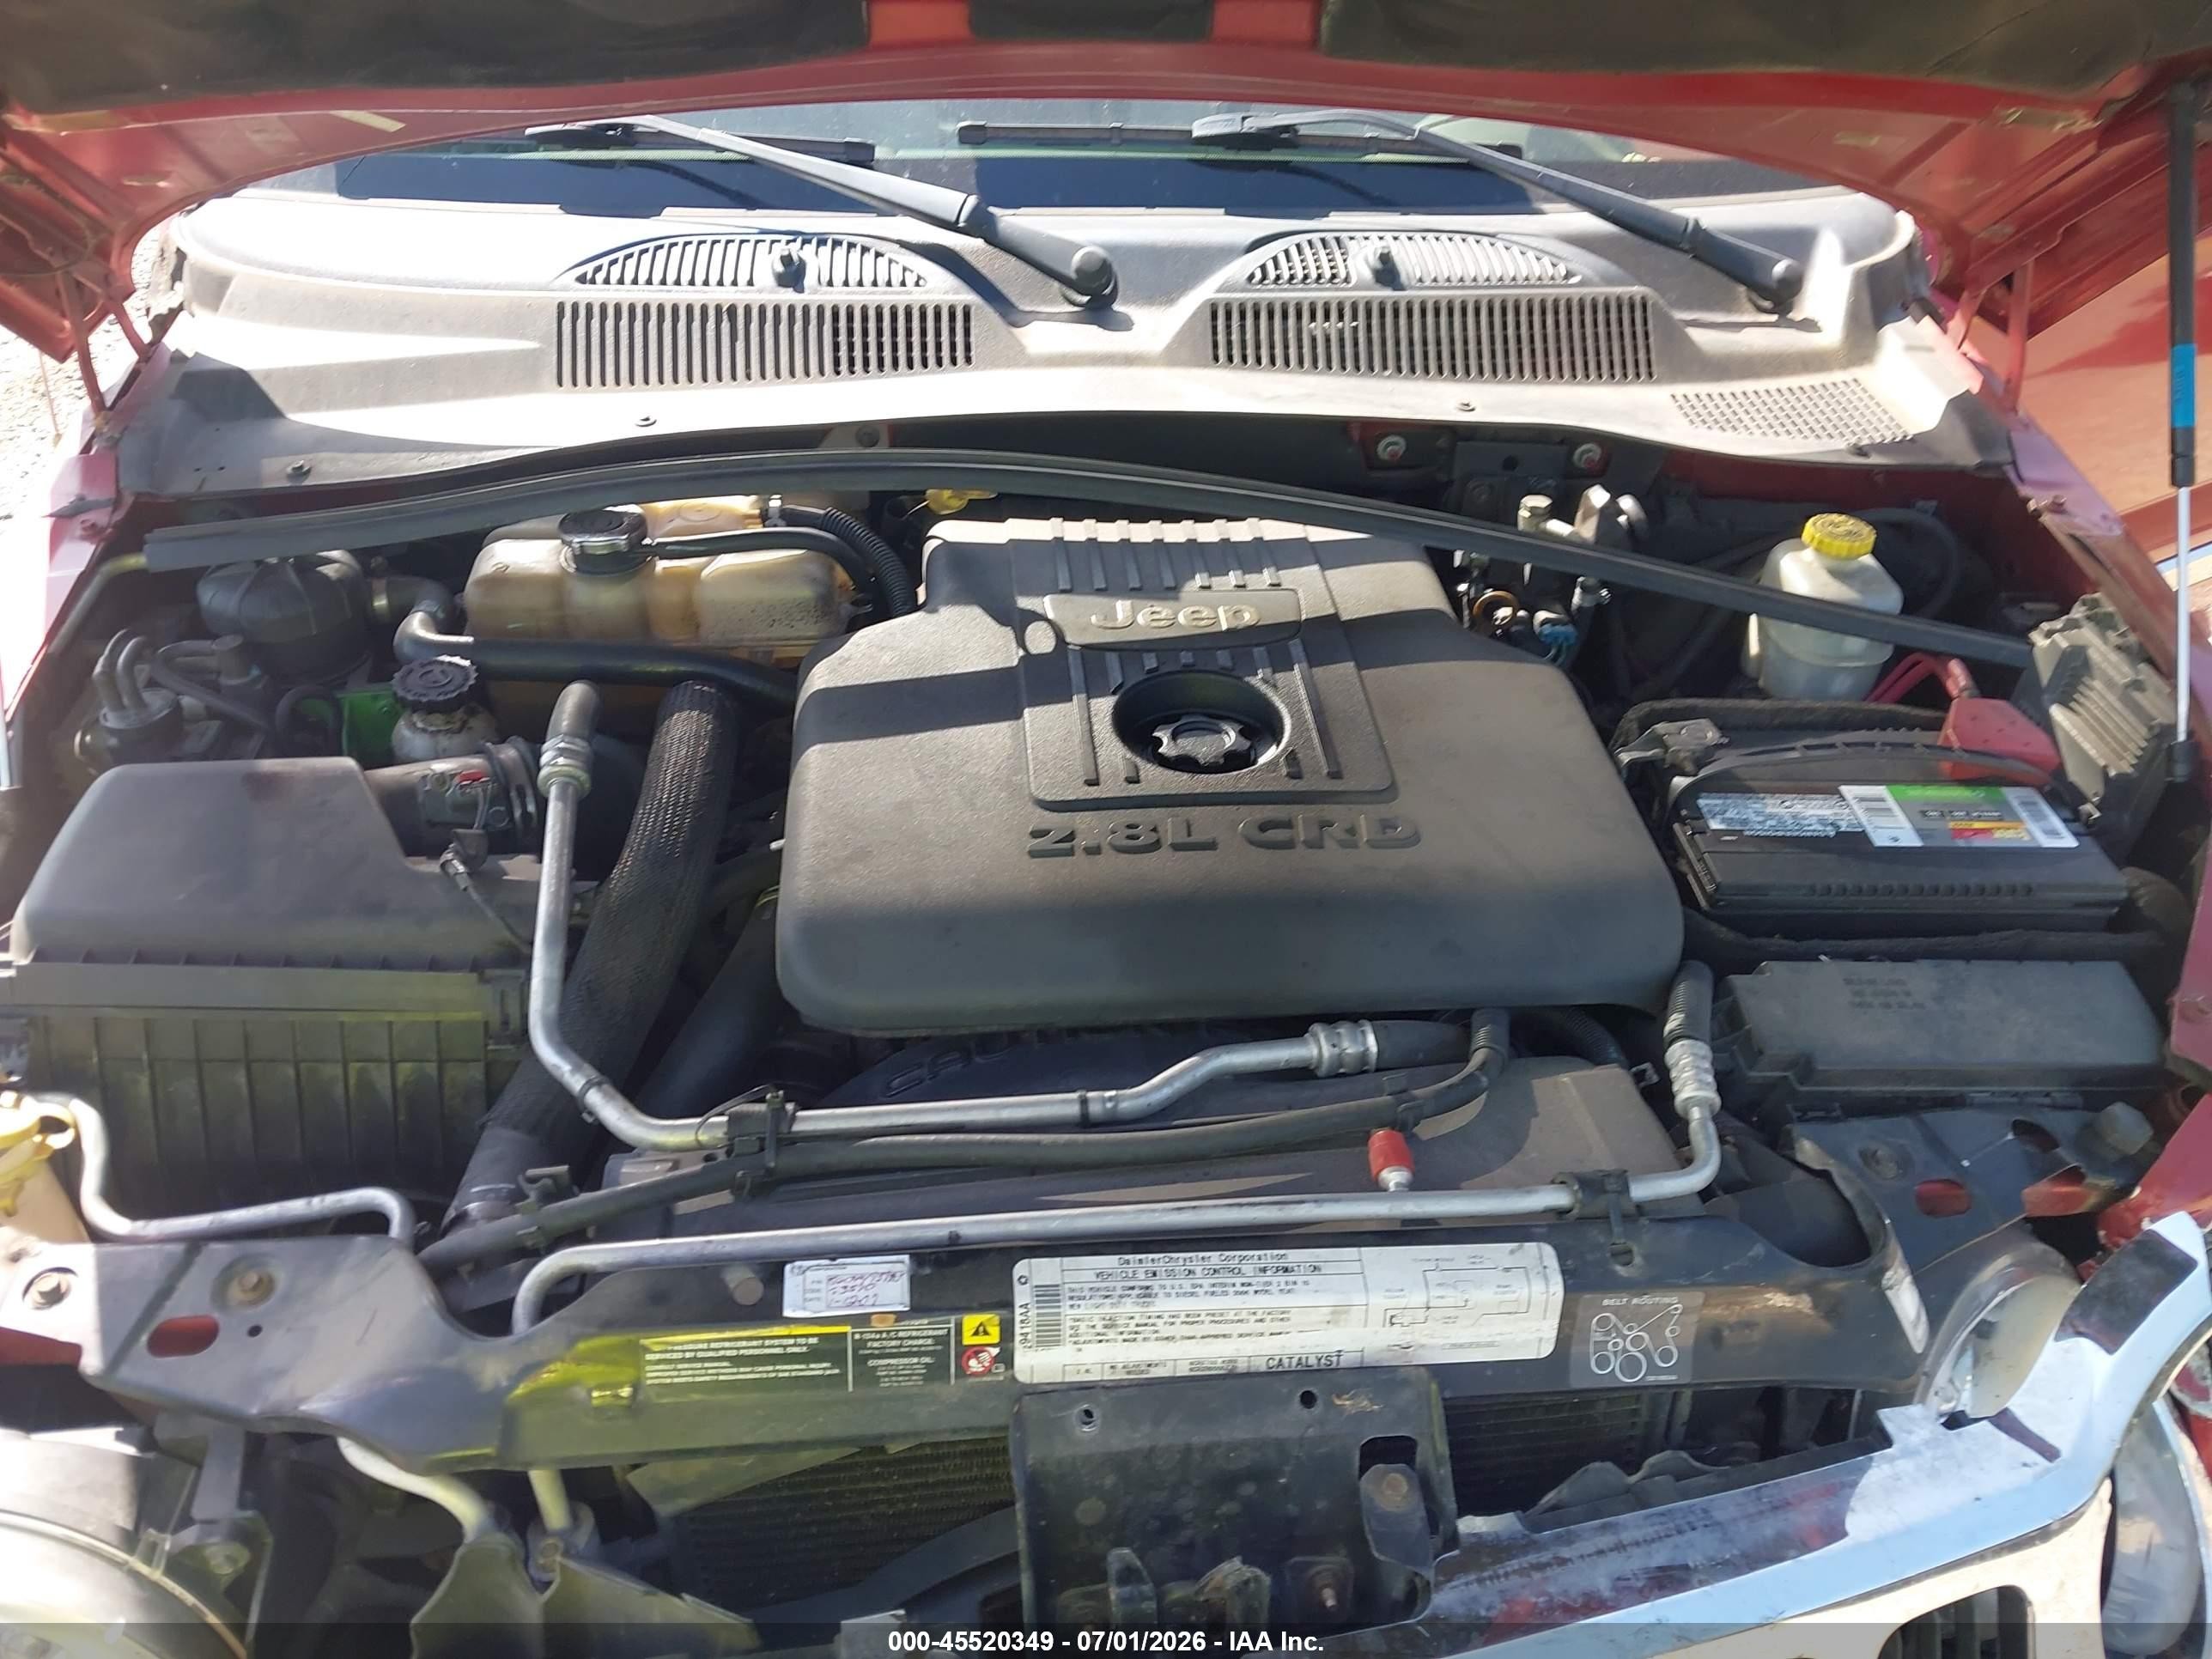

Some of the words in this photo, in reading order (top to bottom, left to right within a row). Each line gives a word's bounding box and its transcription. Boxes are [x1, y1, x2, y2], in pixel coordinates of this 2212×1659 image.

[1090, 599, 1261, 632] Jeep
[1026, 814, 1218, 859] 2.8L
[1238, 811, 1421, 850] CRD
[1218, 1252, 1289, 1265] Corporation
[1095, 1269, 1139, 1280] VEHICLE
[1144, 1267, 1197, 1278] EMISSION
[1201, 1266, 1247, 1277] CONTROL
[1253, 1264, 1322, 1275] INFORMATION
[1601, 1297, 1630, 1306] BELT
[1631, 1296, 1679, 1305] ROUTING
[1266, 1353, 1343, 1371] CATALYST
